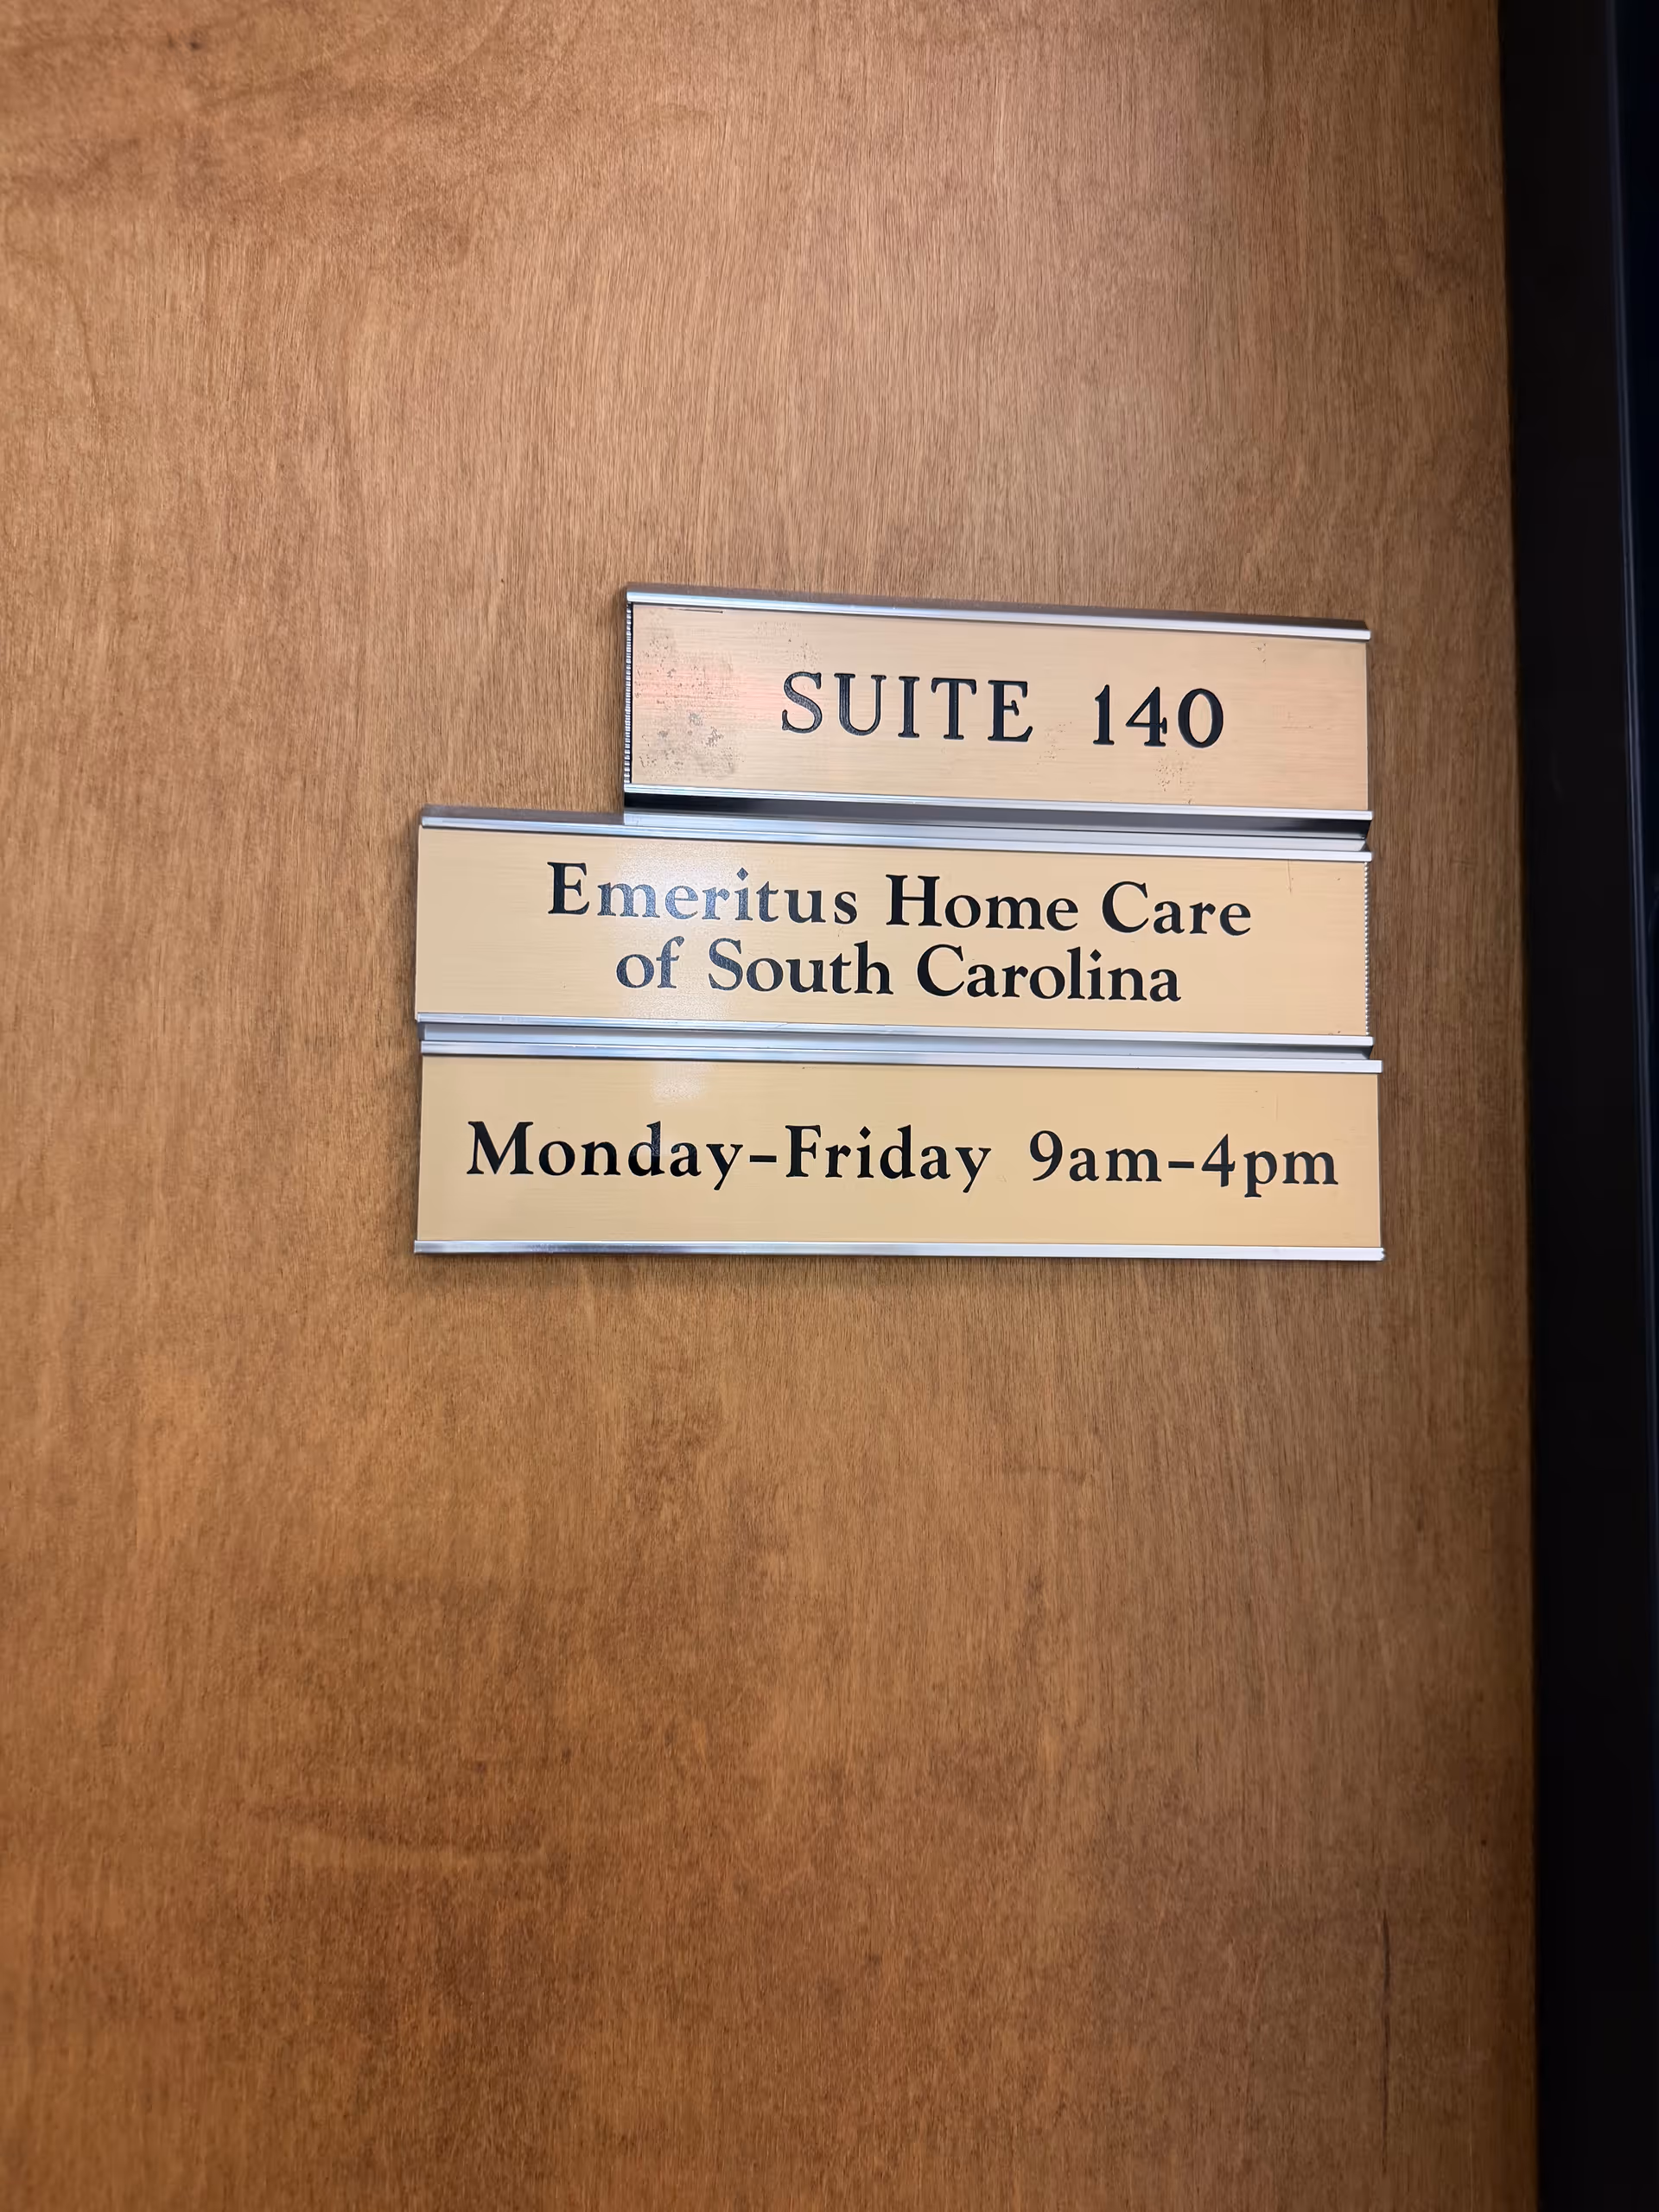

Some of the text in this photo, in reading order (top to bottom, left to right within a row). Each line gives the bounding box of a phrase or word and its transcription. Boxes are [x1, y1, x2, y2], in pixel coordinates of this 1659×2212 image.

[781, 671, 1224, 748] SUITE 140
[547, 861, 1251, 937] Emeritus Home Care
[616, 936, 1182, 1002] of South Carolina
[466, 1121, 1339, 1198] Monday-Friday 9am-4pm
